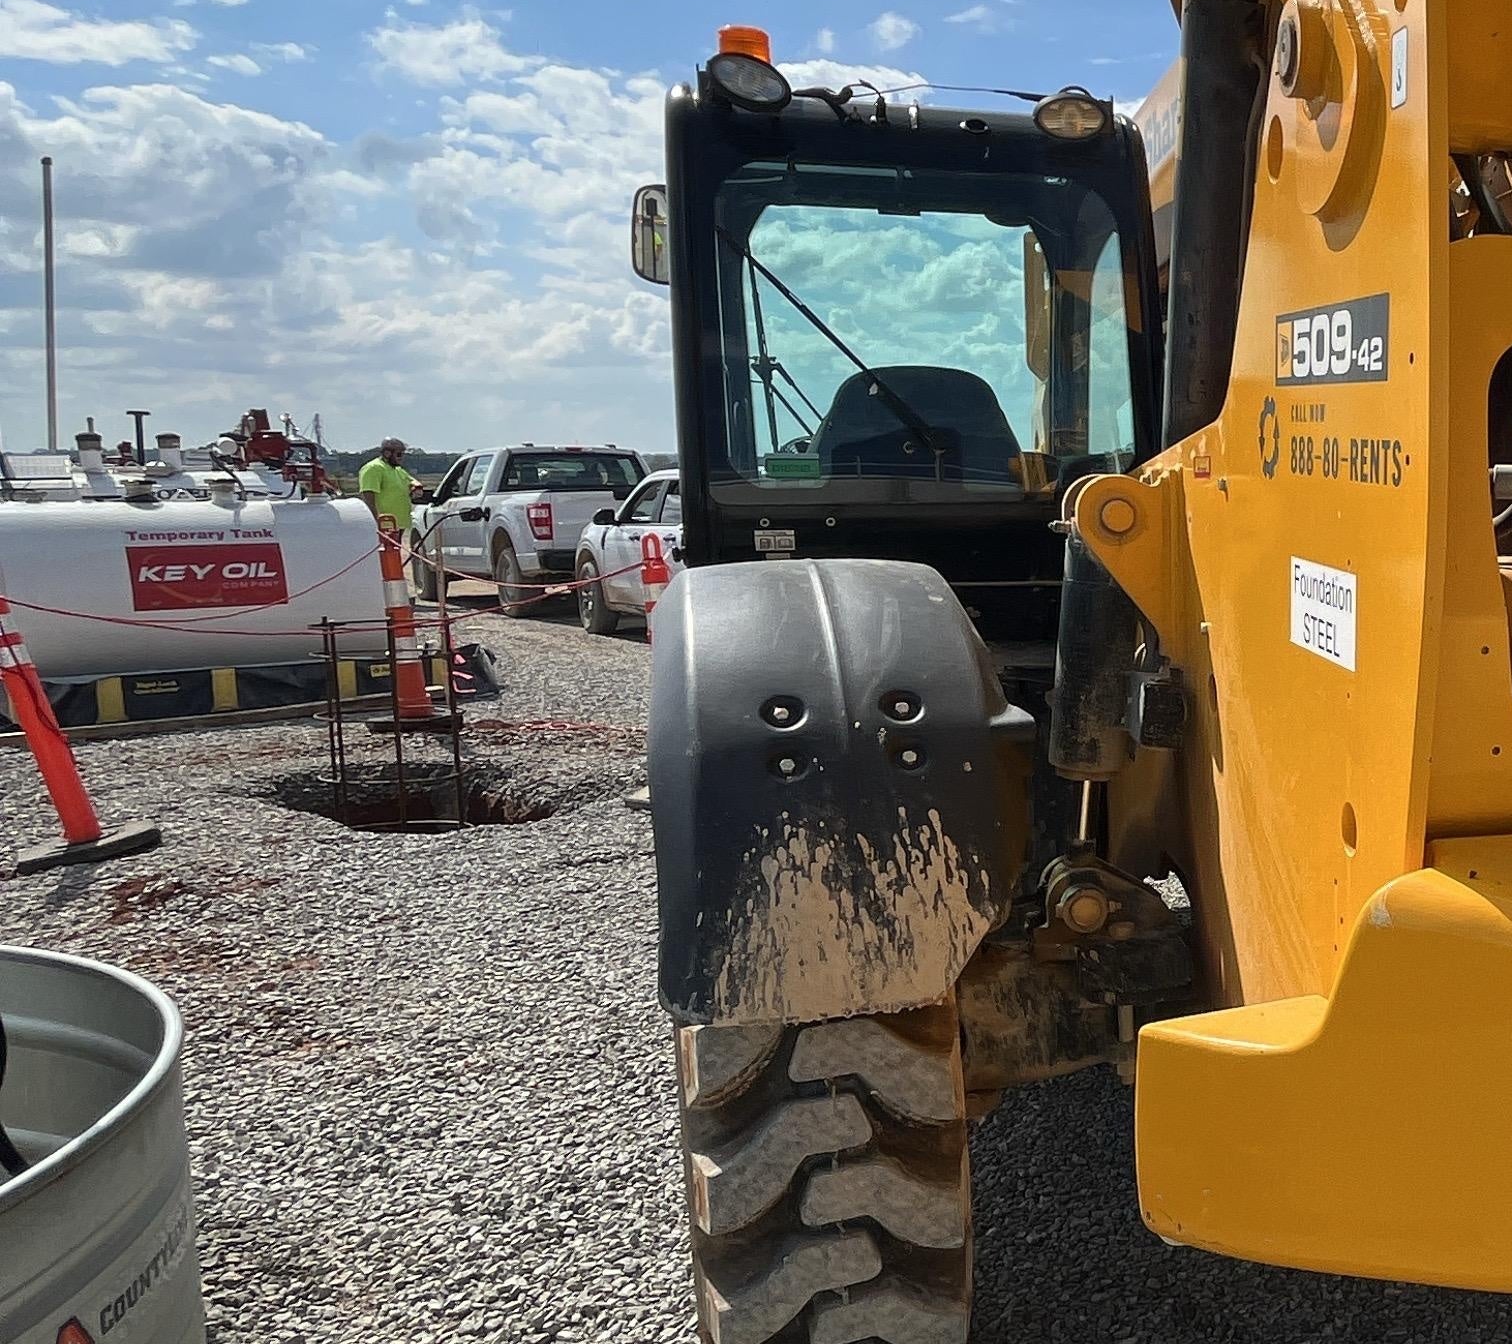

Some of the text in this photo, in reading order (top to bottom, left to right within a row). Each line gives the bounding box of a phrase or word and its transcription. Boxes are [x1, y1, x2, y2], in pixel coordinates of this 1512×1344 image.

[1291, 435, 1402, 488] 888-80-RENTS
[125, 528, 274, 543] Temporary Tank
[138, 561, 278, 583] KEY OIL
[1294, 563, 1353, 614] Foundation
[1303, 612, 1340, 658] STEEL
